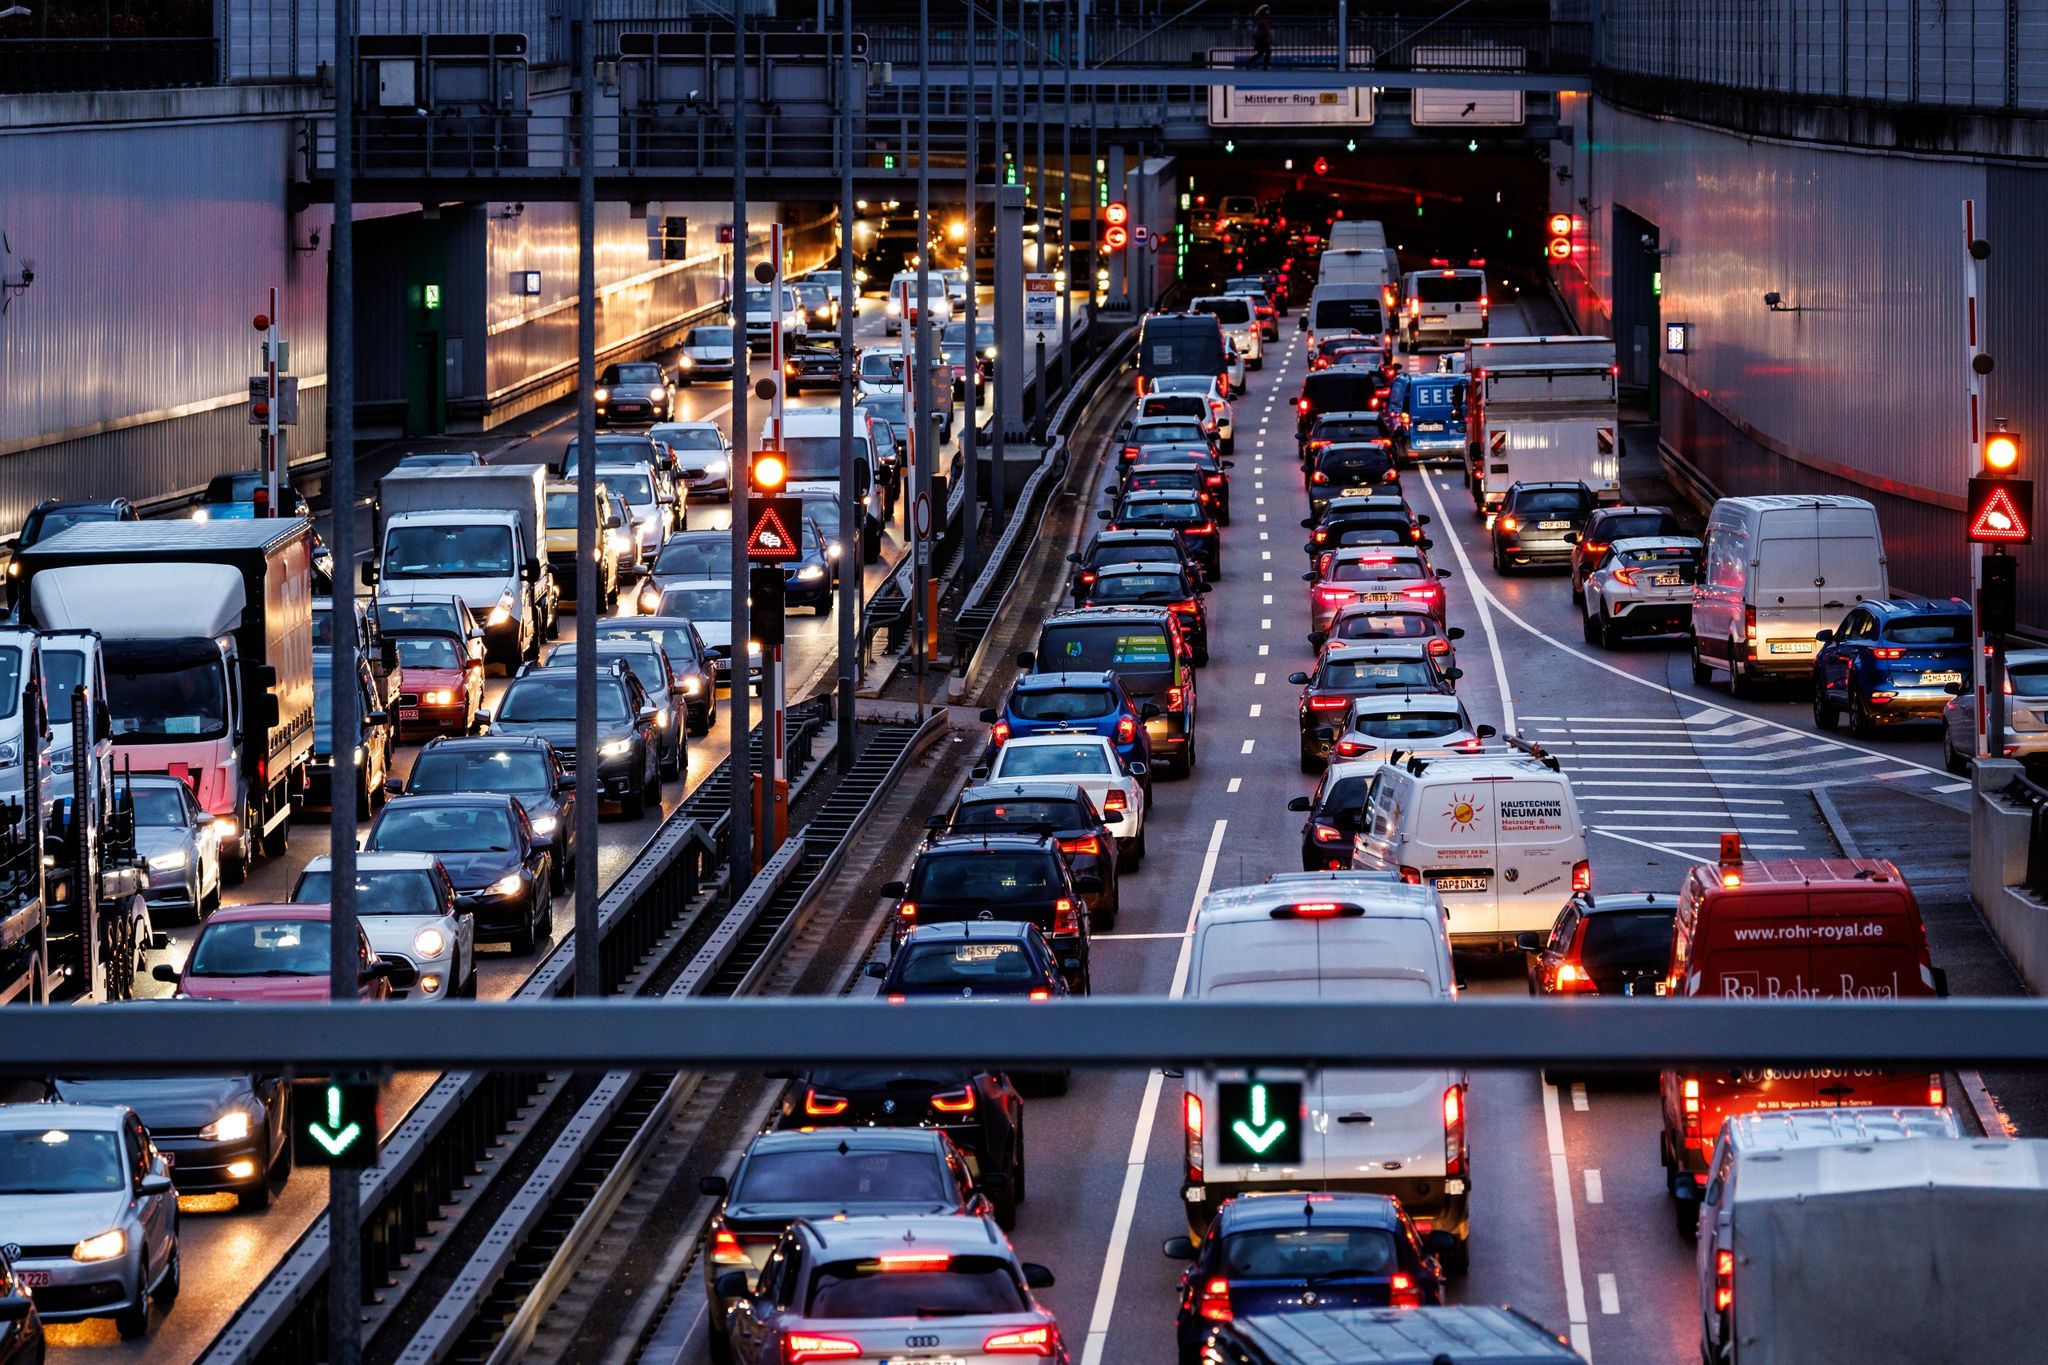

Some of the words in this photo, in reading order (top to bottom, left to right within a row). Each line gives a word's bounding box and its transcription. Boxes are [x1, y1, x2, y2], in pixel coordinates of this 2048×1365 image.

[1244, 94, 1289, 104] Mittlerer
[1293, 95, 1316, 106] Ring
[1943, 674, 1961, 682] 1677
[1500, 800, 1561, 808] HAUSTECHNIK
[1500, 808, 1562, 818] NEUMANN
[1501, 824, 1562, 832] Sanitärtechnik
[1436, 879, 1455, 890] GAP
[1461, 879, 1474, 889] DN
[1475, 879, 1486, 888] 14
[1734, 922, 1884, 942] www.rohr-royal.de
[963, 946, 970, 957] M
[976, 946, 987, 956] ST
[1767, 974, 1820, 1001] Rohr
[1781, 1101, 1800, 1110] Tagen
[29, 1273, 50, 1287] 228
